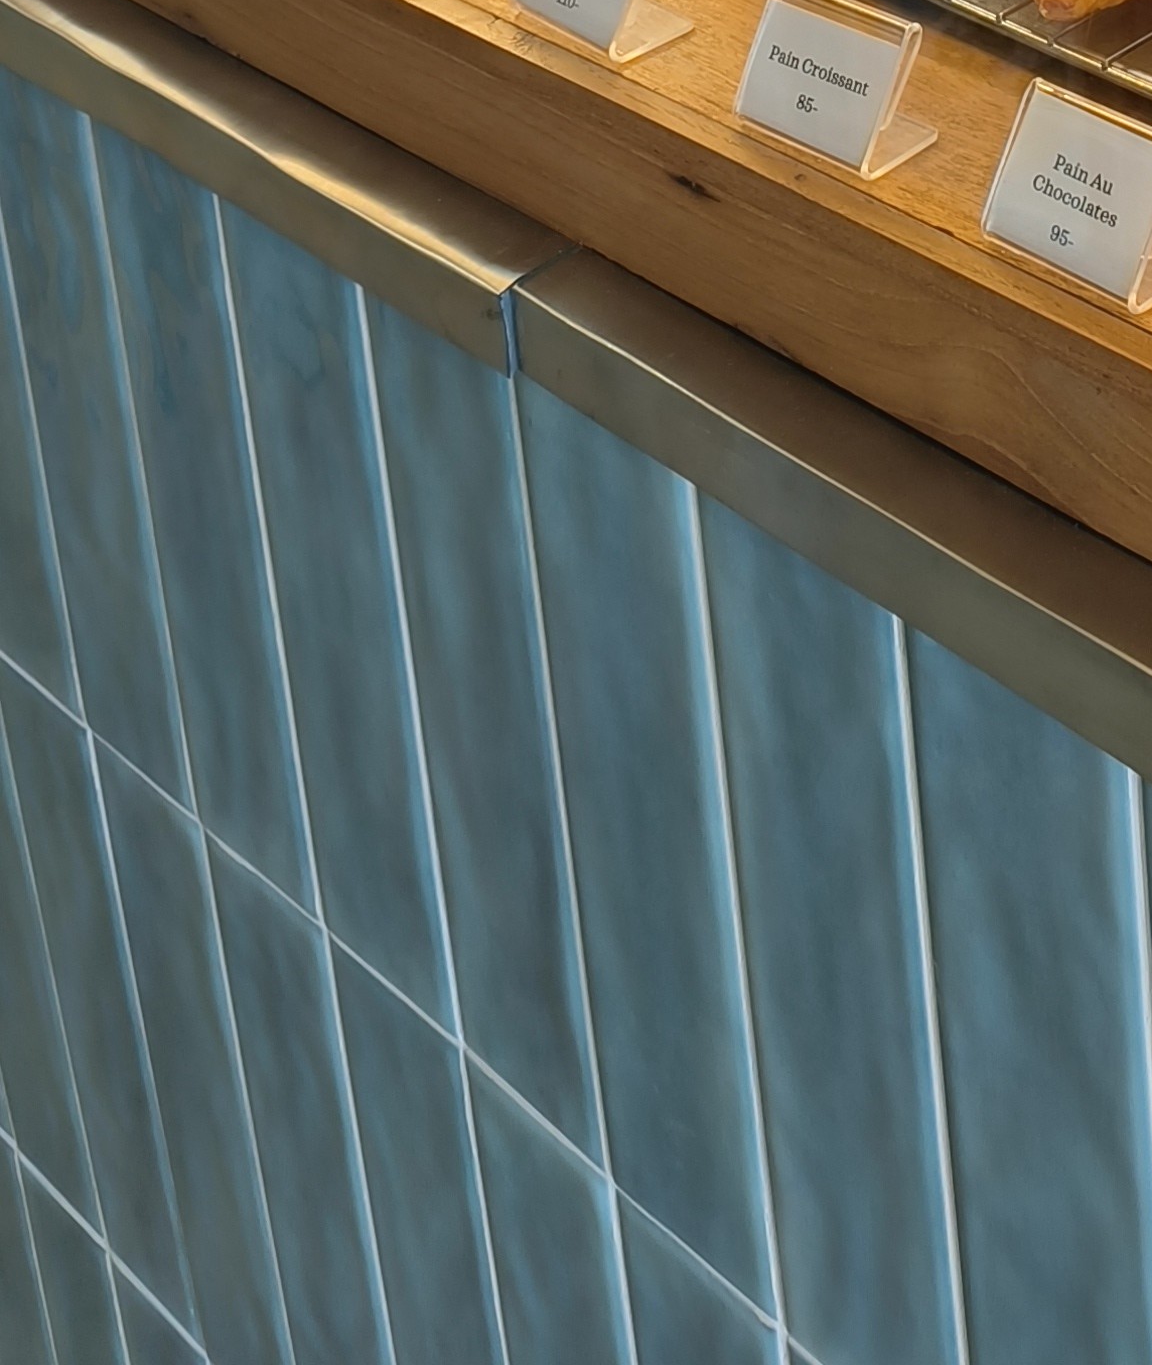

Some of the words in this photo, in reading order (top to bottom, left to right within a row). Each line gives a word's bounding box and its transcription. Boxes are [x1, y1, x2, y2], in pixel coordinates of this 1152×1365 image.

[768, 44, 800, 70] Pain
[801, 58, 869, 97] Croissant
[796, 94, 818, 113] 85-
[1052, 153, 1089, 184] Pain
[1089, 173, 1114, 195] Au
[1032, 174, 1118, 227] Chocolates
[1050, 225, 1074, 246] 95-
